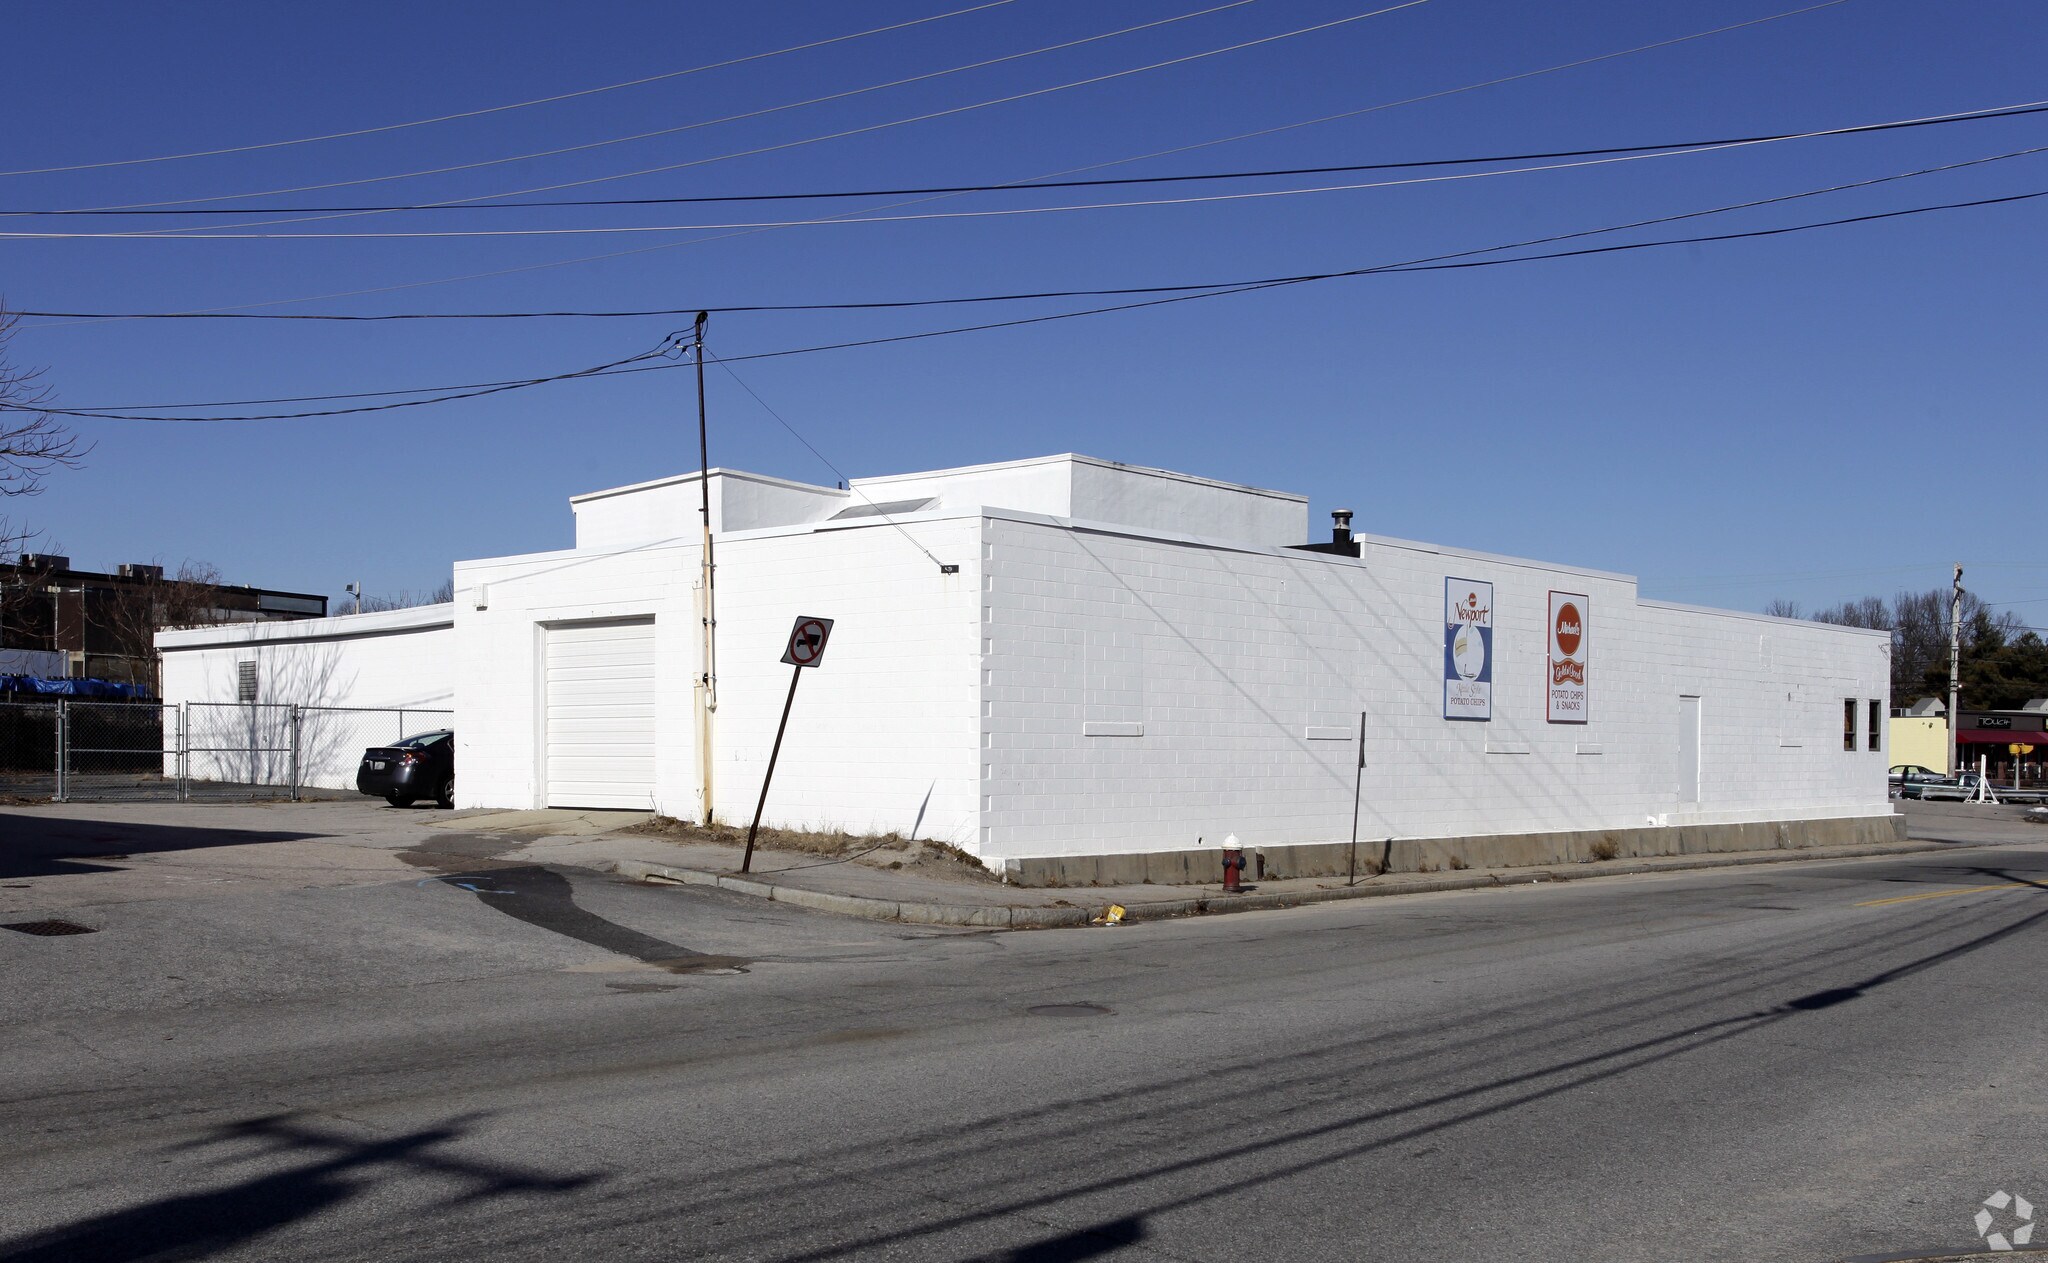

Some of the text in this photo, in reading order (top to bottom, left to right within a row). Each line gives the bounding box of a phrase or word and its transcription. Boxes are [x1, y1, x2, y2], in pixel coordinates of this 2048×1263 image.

[1455, 602, 1490, 628] Newport
[1551, 689, 1584, 701] POTATO CHIPS
[1450, 697, 1486, 707] POTATO CHIPS
[1555, 700, 1581, 711] & SNACKS
